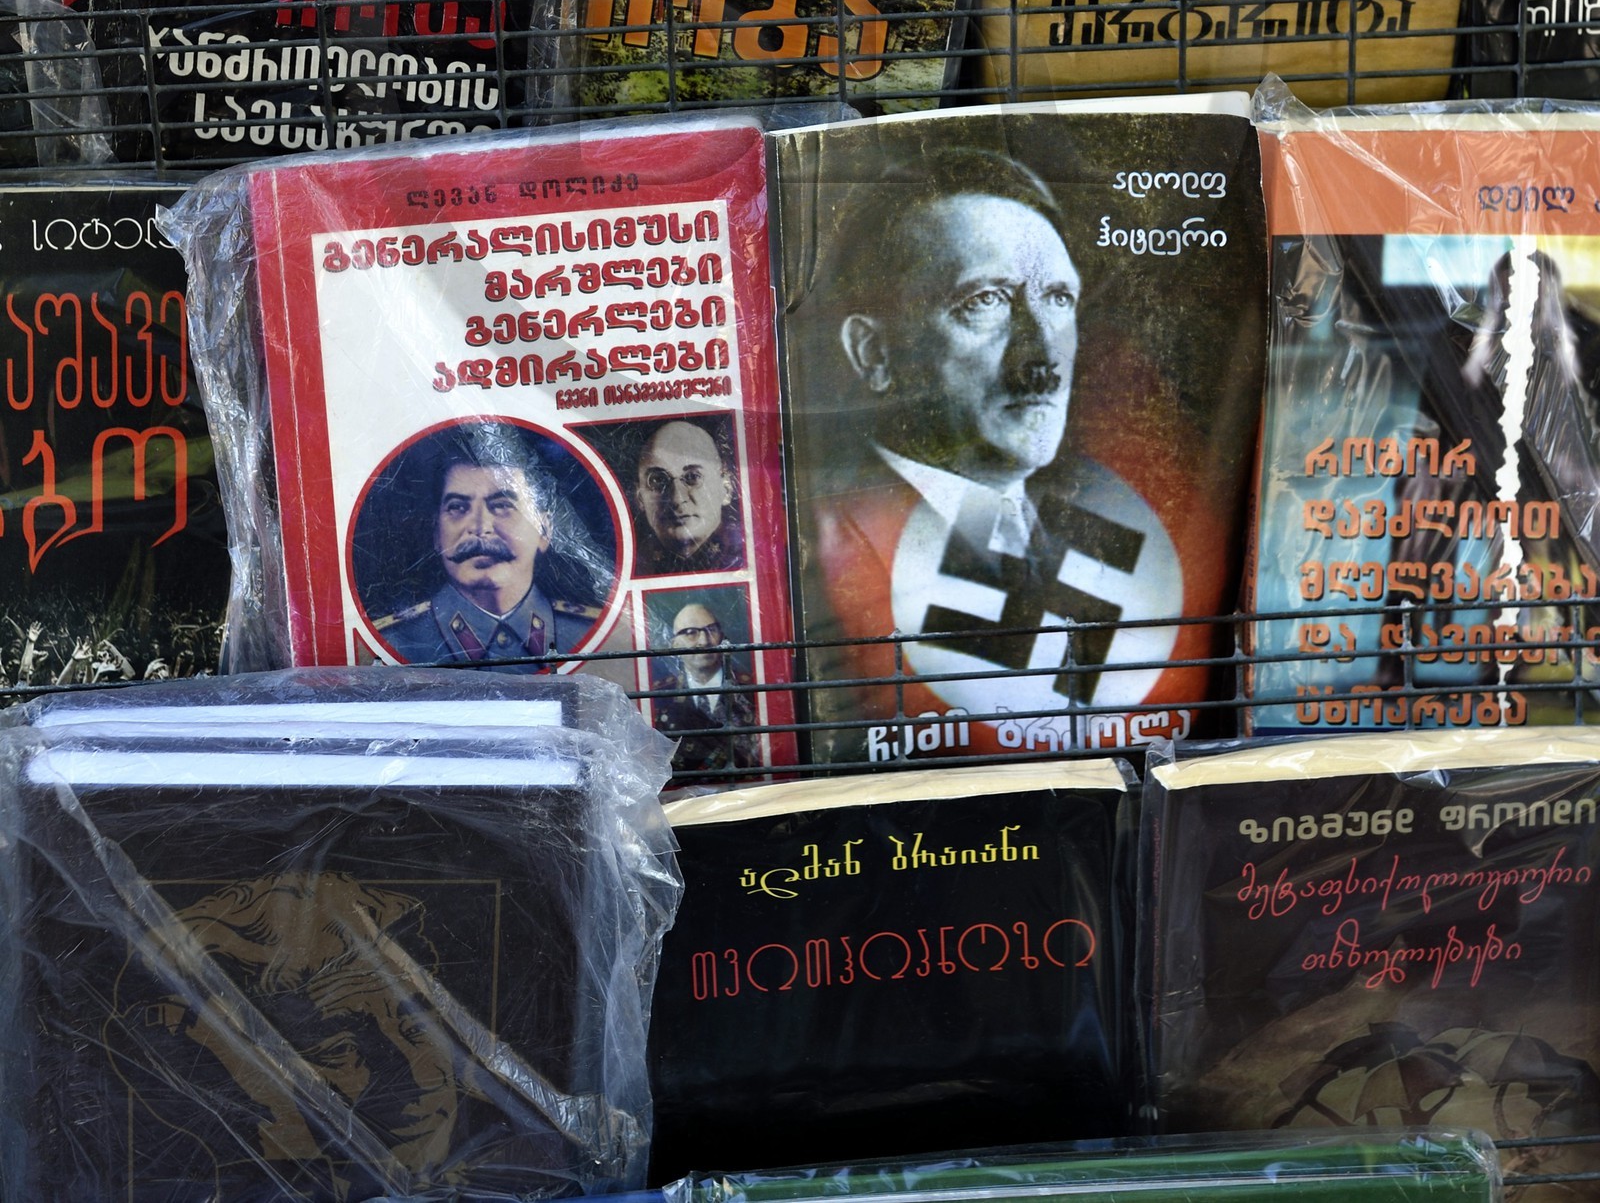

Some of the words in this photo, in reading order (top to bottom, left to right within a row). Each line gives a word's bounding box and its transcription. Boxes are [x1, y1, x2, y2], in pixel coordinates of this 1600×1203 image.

[194, 92, 494, 151] სამსახუ
[406, 183, 498, 209] ლევან
[518, 172, 639, 200] დოლიძე
[1112, 171, 1227, 198] ადოლფ
[1478, 185, 1575, 213] დეილ
[322, 209, 721, 274] გენერალისიმუსი
[1096, 215, 1228, 256] ჰიტლერი
[484, 252, 723, 302] მარშლები
[464, 295, 727, 347] გენერლები
[432, 338, 730, 393] ადმირალები
[555, 386, 599, 411] ჩვენი
[1304, 437, 1476, 478] როგორ
[1303, 499, 1560, 539] დავძლიოთ
[1300, 561, 1598, 601] მღელვარება
[1299, 623, 1356, 663] და
[867, 707, 970, 763] ჩემი
[1238, 807, 1415, 844] ზიგმუნდ
[1438, 798, 1597, 831] ფროიდი
[888, 824, 1041, 871] ბრაიანი
[1236, 846, 1593, 920] მეტაფსიქოლოგიური
[691, 918, 1097, 1000] თვითჰიპნოზი
[1301, 918, 1522, 989] თხზულებები
